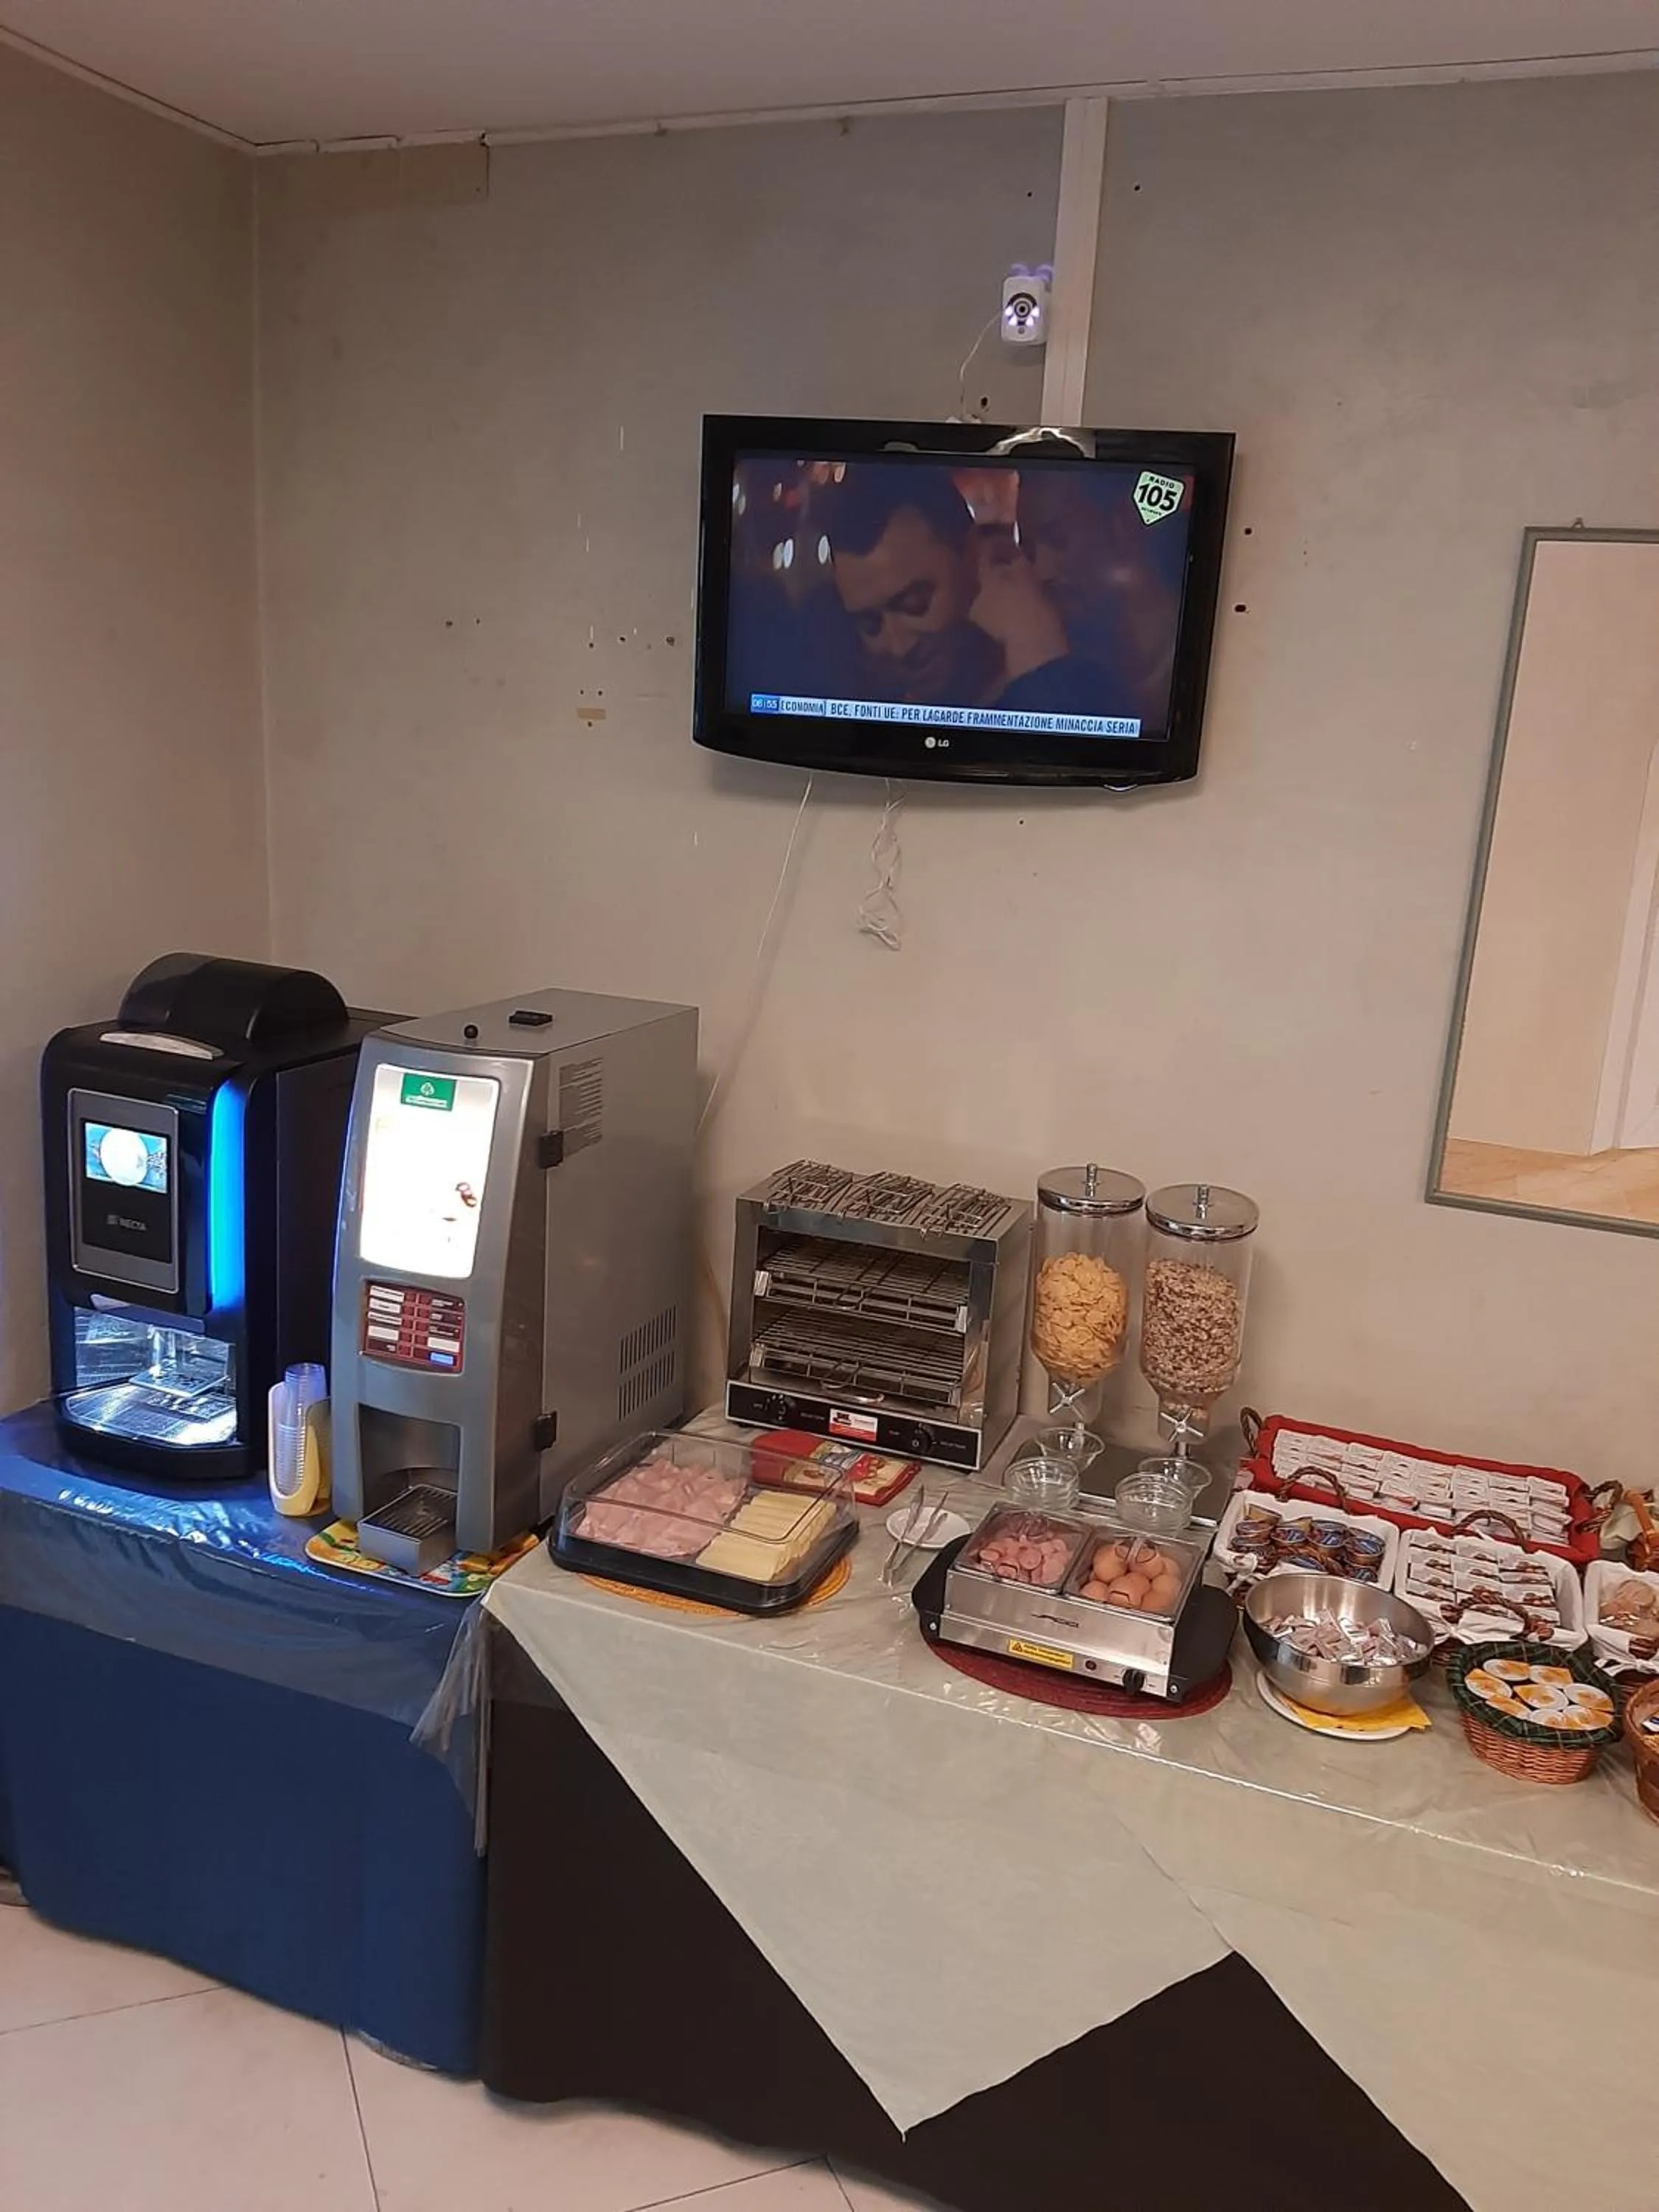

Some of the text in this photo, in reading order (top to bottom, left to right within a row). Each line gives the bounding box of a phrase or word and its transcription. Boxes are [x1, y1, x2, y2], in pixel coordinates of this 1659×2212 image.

[1150, 476, 1175, 488] RADIO
[1138, 483, 1178, 511] 105
[855, 704, 881, 717] FONTI
[902, 708, 920, 720] PER
[922, 709, 964, 723] LAGARDE
[967, 712, 1054, 729] FRAMMENTAZIONE
[1055, 717, 1104, 732] MINACCIA
[1106, 720, 1135, 734] SERIA
